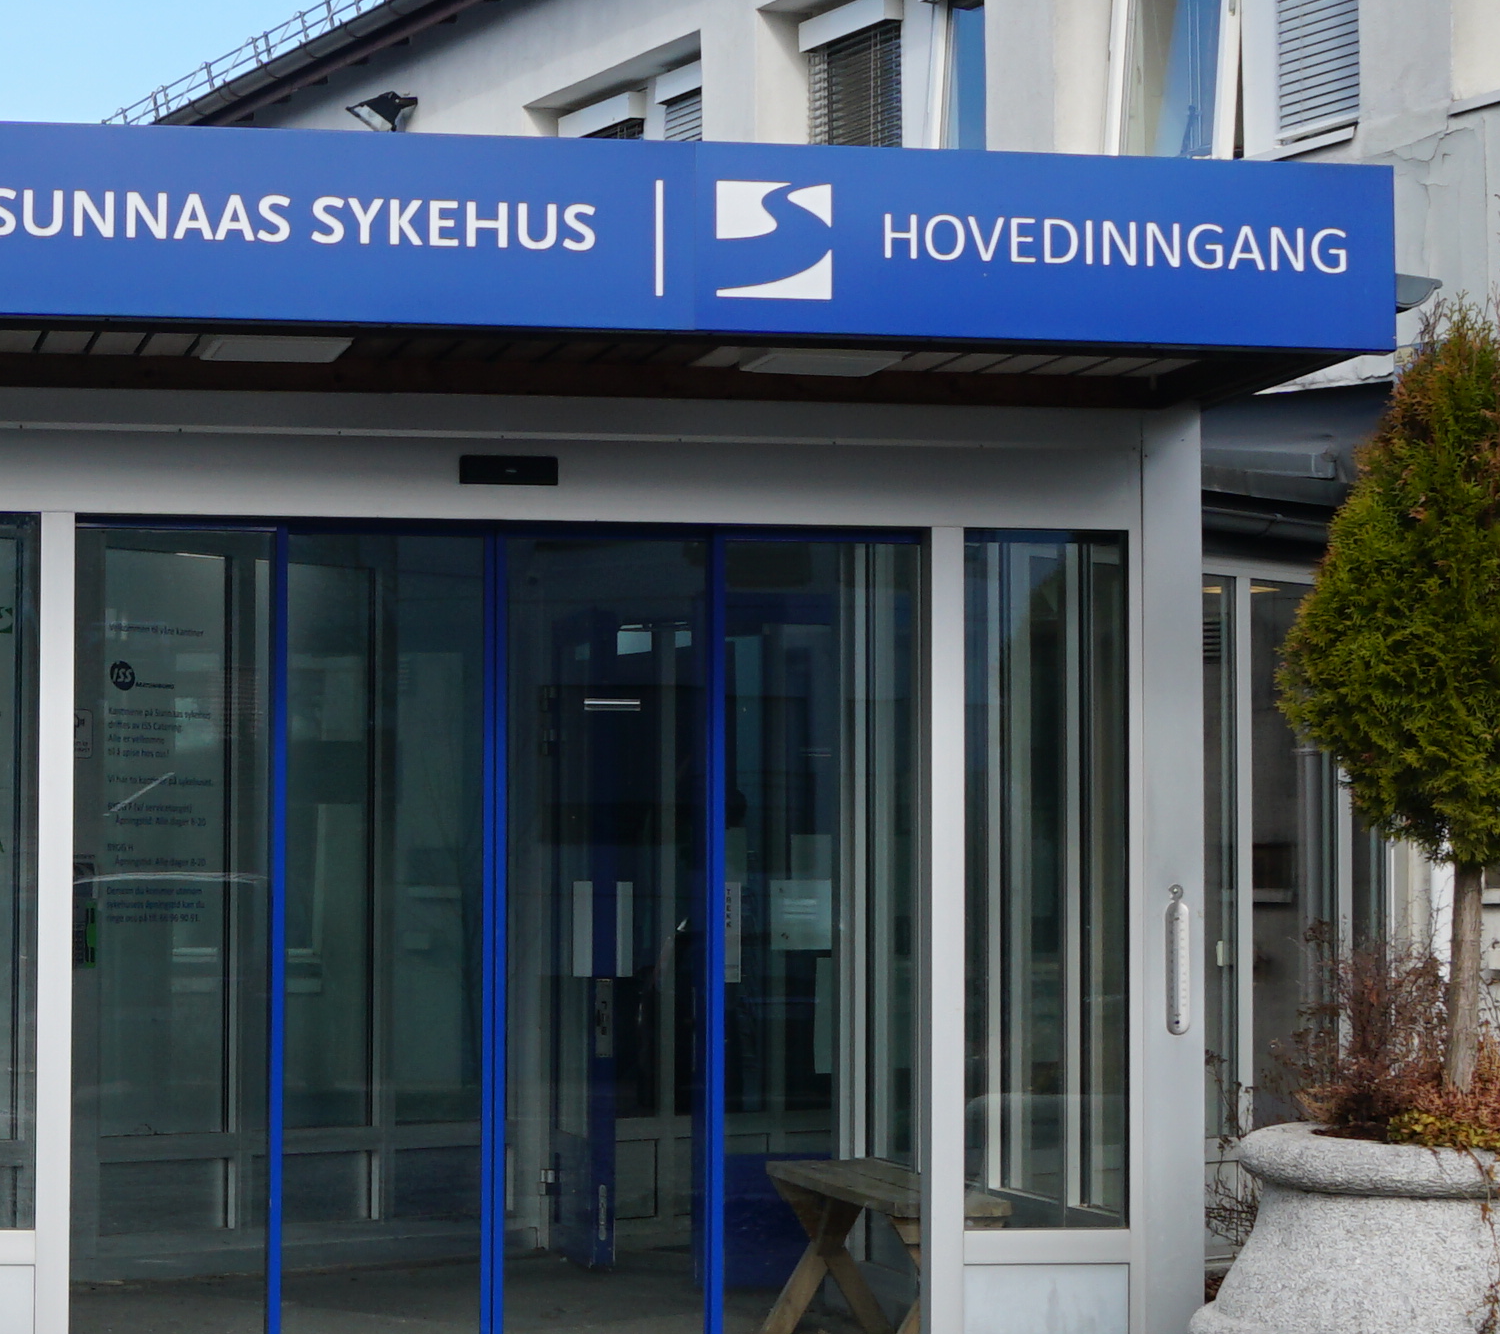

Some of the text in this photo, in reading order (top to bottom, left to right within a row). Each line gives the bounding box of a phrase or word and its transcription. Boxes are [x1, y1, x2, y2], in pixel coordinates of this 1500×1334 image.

[311, 196, 596, 251] SYKEHUS
[884, 213, 1347, 274] HOVEDINNGANG
[113, 668, 133, 683] ISS
[141, 722, 151, 730] ISS
